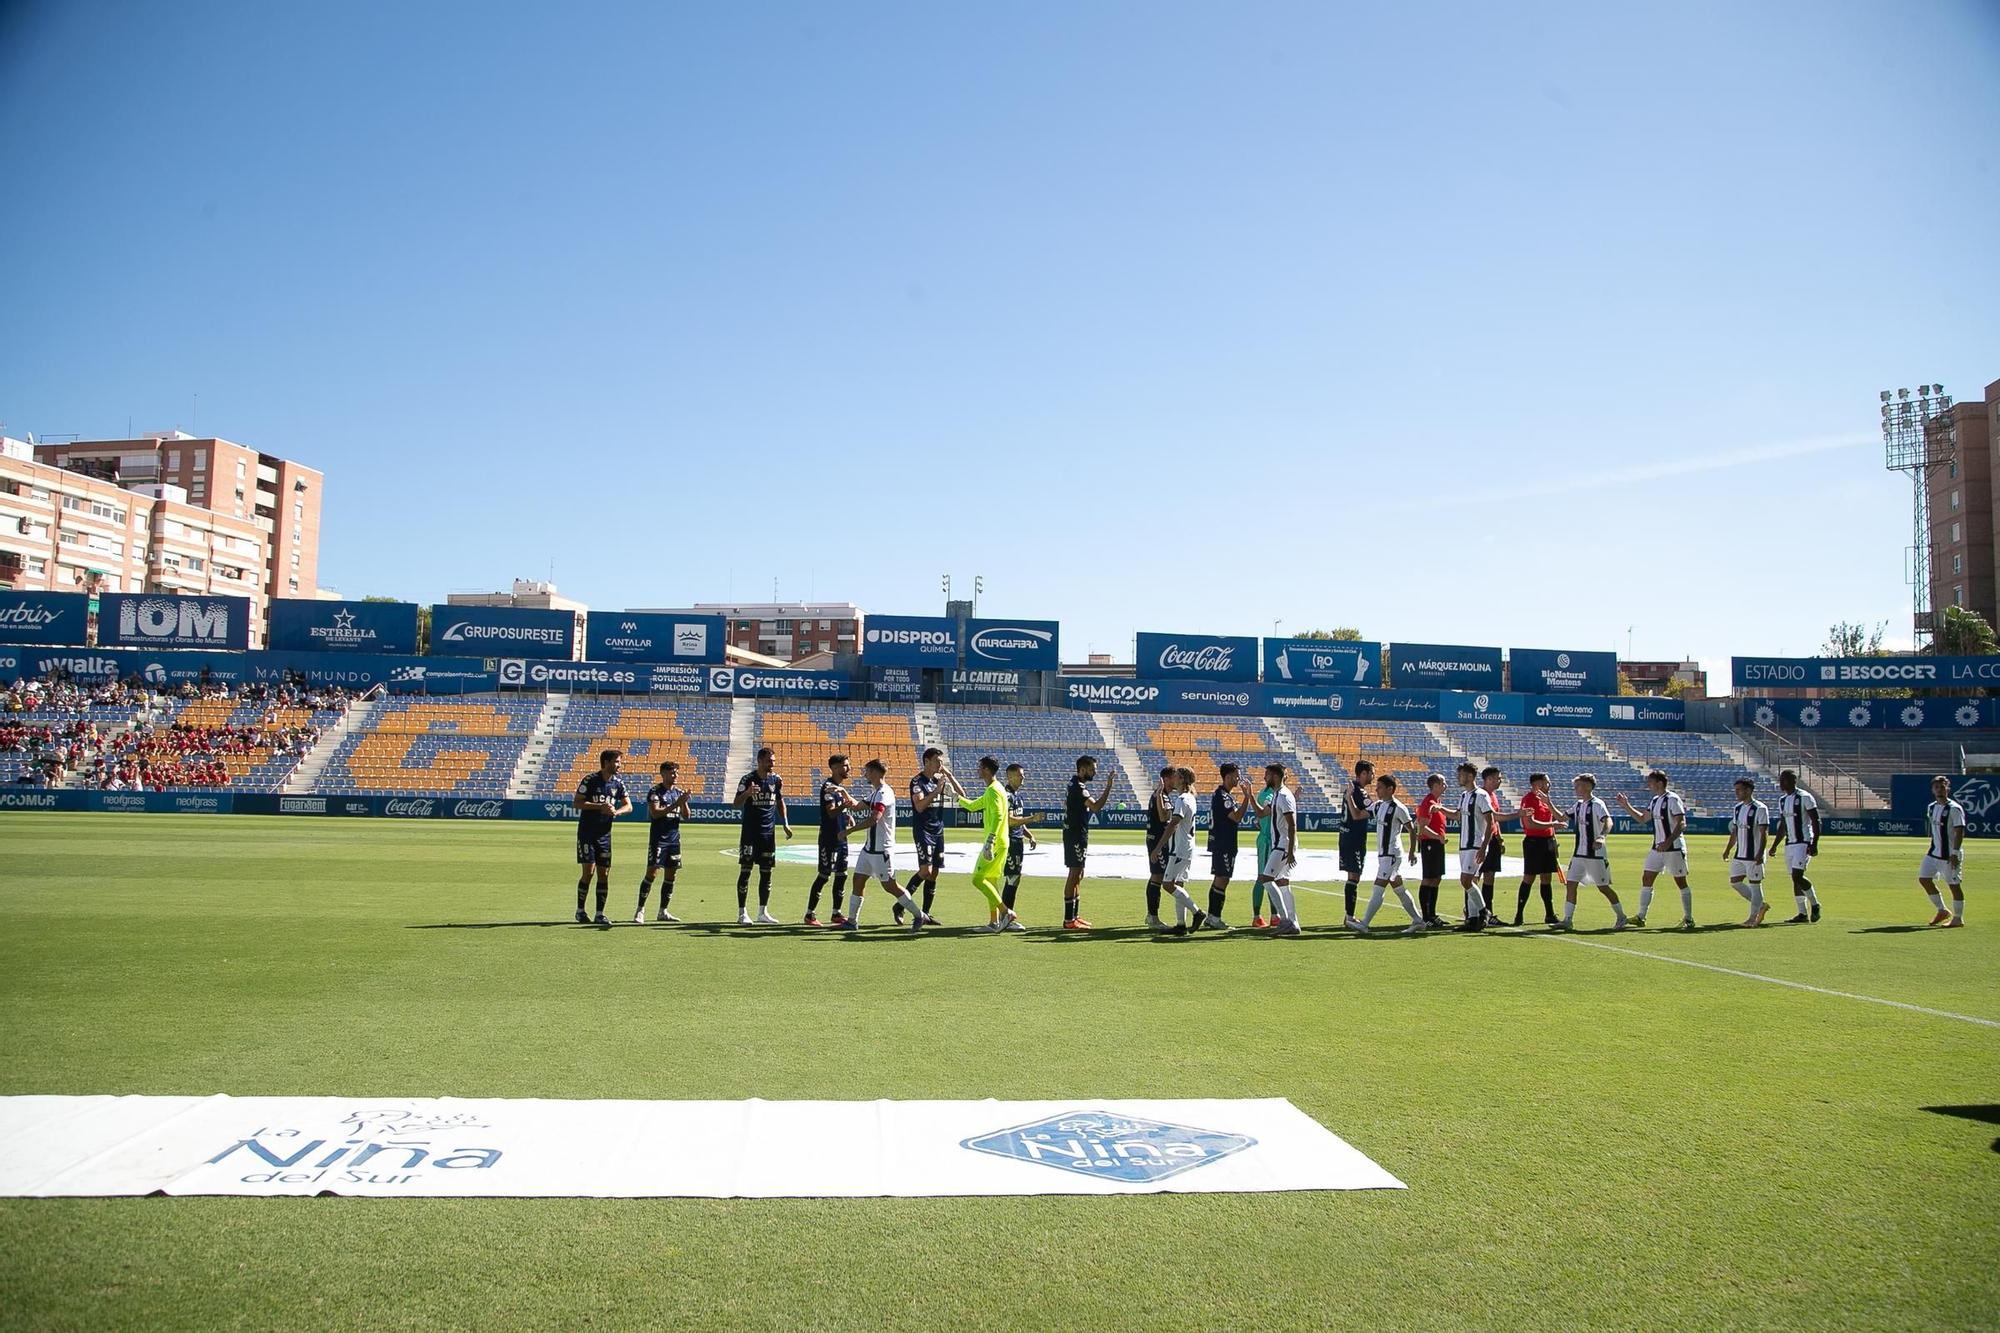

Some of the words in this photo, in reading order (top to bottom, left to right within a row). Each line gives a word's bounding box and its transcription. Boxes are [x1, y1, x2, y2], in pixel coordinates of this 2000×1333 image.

[119, 599, 228, 638] IOM
[310, 627, 377, 638] ESTRELLA
[464, 626, 563, 642] GRUPOSURESTE
[881, 630, 956, 645] DISPROL
[605, 638, 652, 647] CANTALAR
[919, 645, 956, 653] QUÍMICA
[1159, 644, 1235, 671] Coca-Cola
[1418, 659, 1458, 671] MÁRQUEZ
[1459, 662, 1492, 672] MOLINA
[1745, 664, 1805, 681] ESTADIO
[1840, 664, 1937, 680] BESOCCER
[1952, 664, 1974, 679] LA
[255, 665, 371, 682] MAIMUNDO
[530, 664, 636, 683] Granate.es
[952, 670, 967, 683] LA
[969, 671, 1019, 685] CANTERA
[1541, 670, 1587, 680] BioNatural
[739, 673, 840, 691] Granate.es
[874, 683, 920, 693] PRESIDENTE
[1069, 684, 1159, 701] SUMICOOP
[1181, 691, 1236, 701] serunion
[1765, 699, 1775, 707] bp
[1969, 698, 1980, 706] bp
[1458, 711, 1475, 719] San
[1475, 711, 1507, 721] Lorenzo
[1638, 707, 1685, 721] climamur
[1107, 813, 1149, 822] VIVENTA
[1020, 1132, 1052, 1140] La
[203, 1138, 503, 1169] Niña
[1020, 1138, 1209, 1159] Niña
[1071, 1158, 1120, 1168] del
[1130, 1157, 1177, 1167] Sur
[240, 1169, 328, 1183] del
[336, 1170, 423, 1184] Sur
